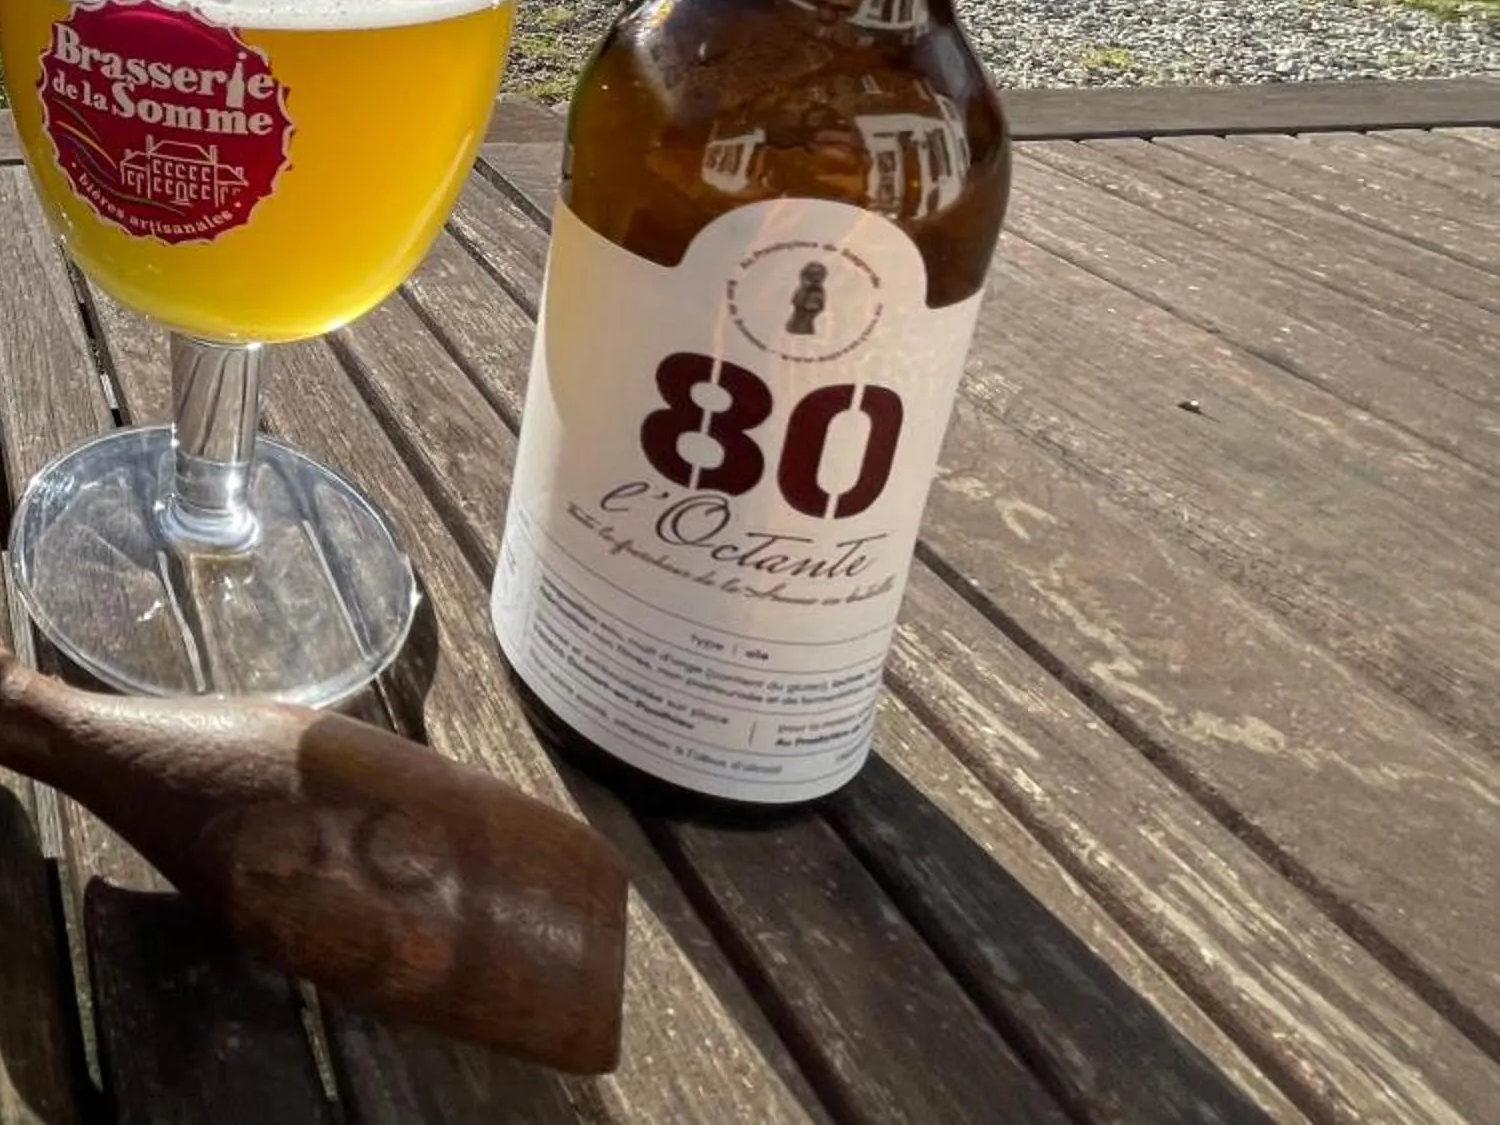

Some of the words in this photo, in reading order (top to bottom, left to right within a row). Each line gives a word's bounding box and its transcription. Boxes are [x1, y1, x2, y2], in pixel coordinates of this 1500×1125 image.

[54, 23, 274, 108] Brasserie
[52, 71, 78, 99] de
[82, 81, 108, 110] la
[112, 82, 273, 135] Somme
[130, 211, 232, 234] artisanales
[640, 351, 904, 520] 80
